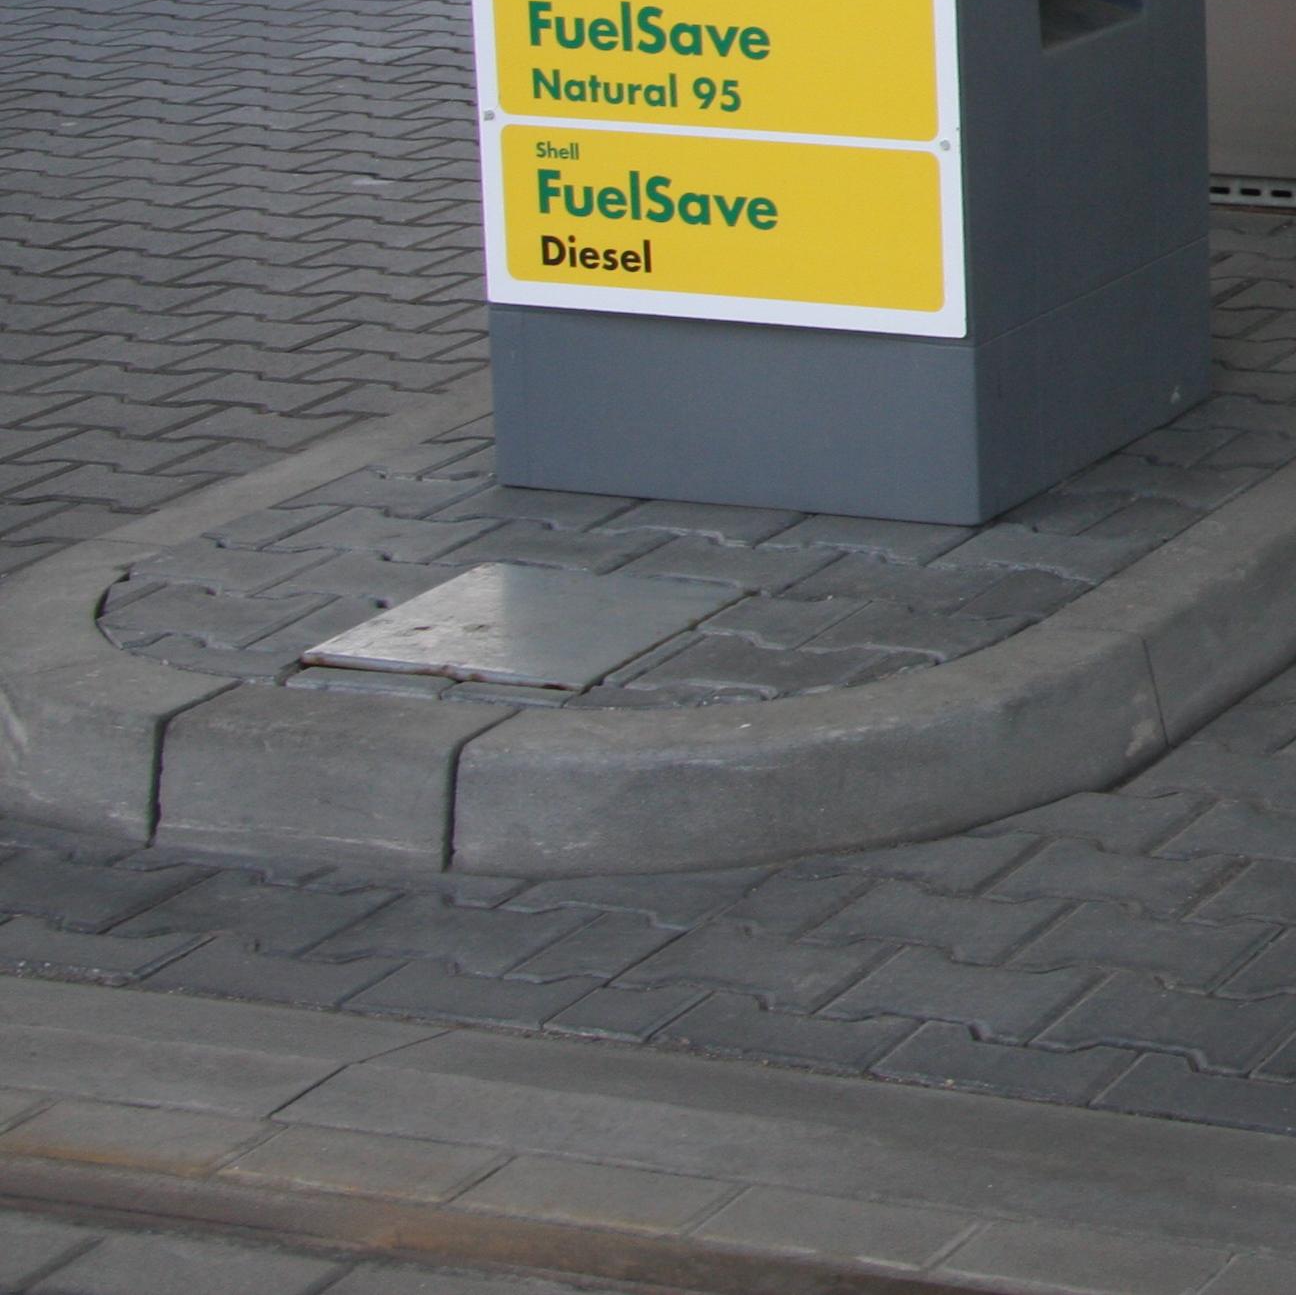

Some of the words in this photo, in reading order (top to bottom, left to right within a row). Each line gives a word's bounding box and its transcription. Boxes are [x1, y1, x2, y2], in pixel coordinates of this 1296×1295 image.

[528, 1, 771, 61] FuelSave
[532, 68, 678, 108] Natural
[692, 77, 742, 113] 95
[536, 141, 580, 161] Shell
[537, 169, 779, 231] FuelSave
[541, 235, 653, 274] Diesel
